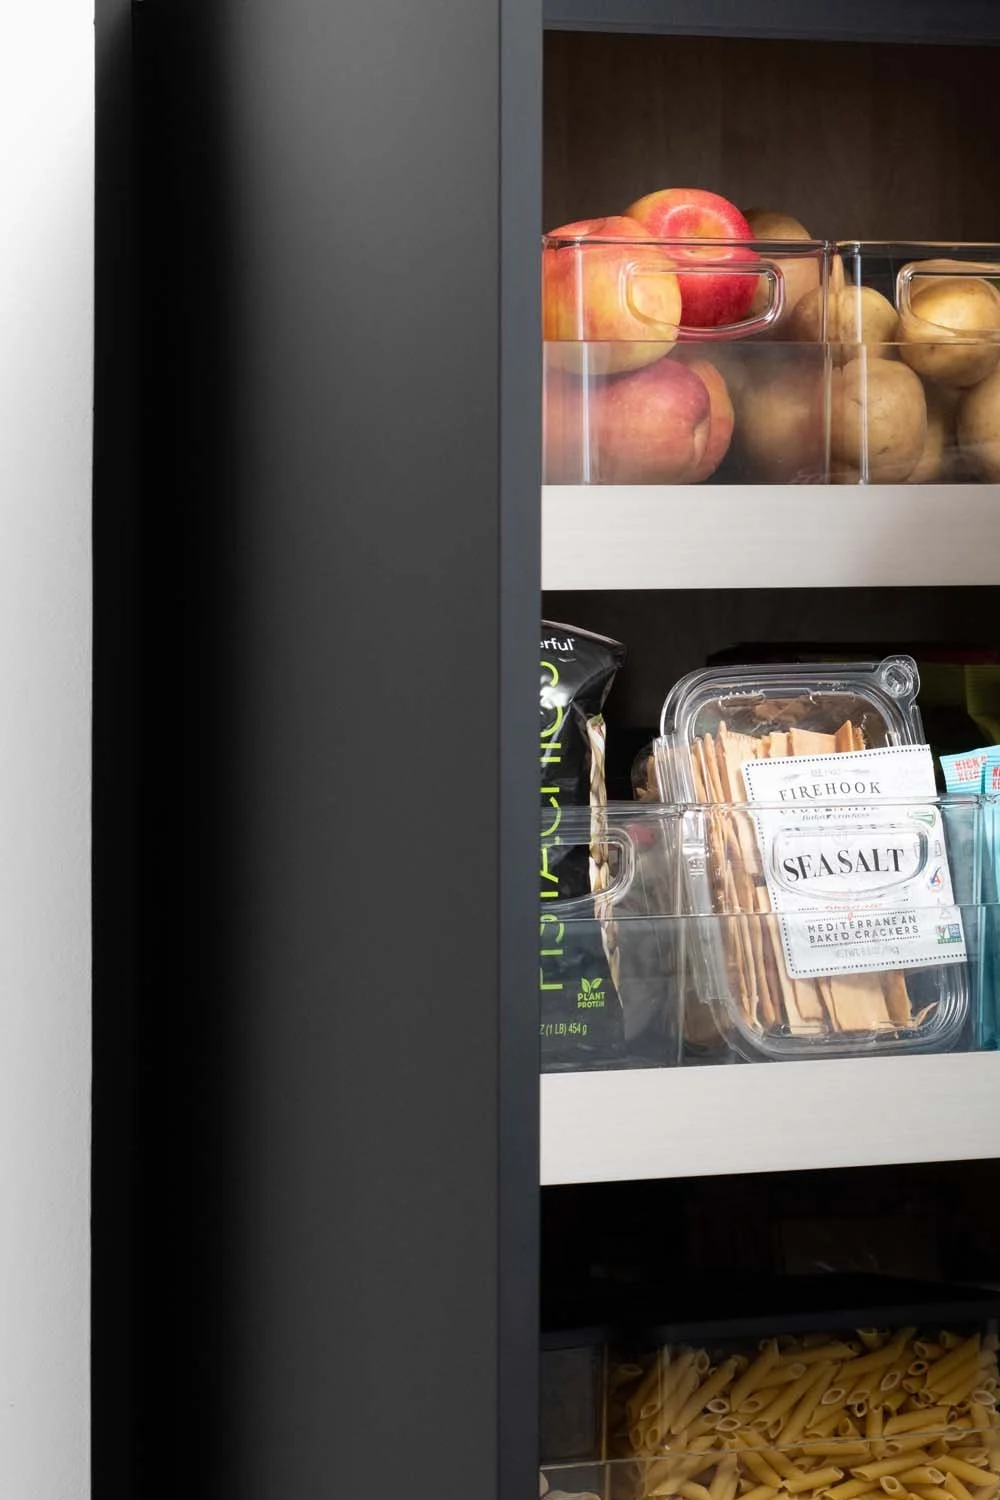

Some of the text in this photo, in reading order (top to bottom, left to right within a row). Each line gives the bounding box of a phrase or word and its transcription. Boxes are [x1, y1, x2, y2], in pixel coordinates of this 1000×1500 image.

[778, 781, 881, 801] FIREHOOK
[783, 848, 904, 883] SEA SALT
[807, 915, 917, 934] MEDITERRANEAN
[809, 925, 919, 944] BAKED CRACKERS
[577, 991, 606, 1001] PLANT
[568, 1022, 581, 1034] 454
